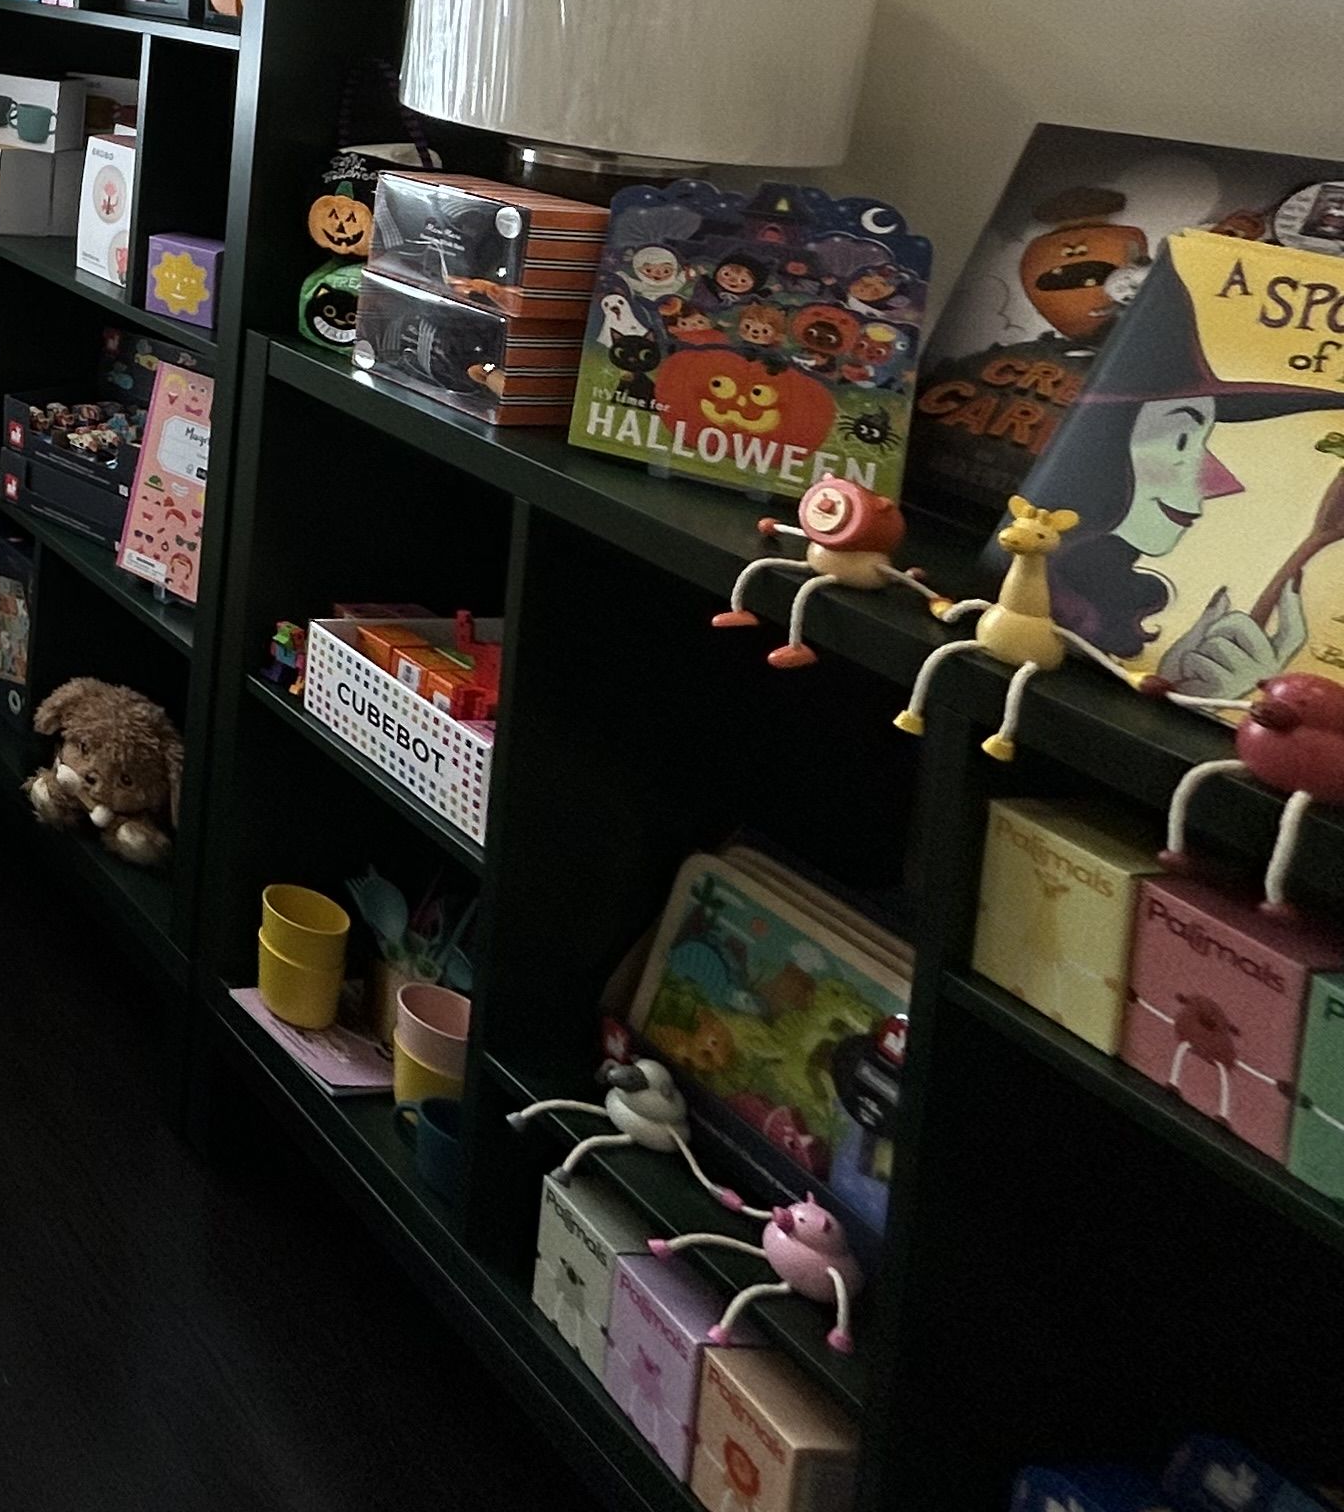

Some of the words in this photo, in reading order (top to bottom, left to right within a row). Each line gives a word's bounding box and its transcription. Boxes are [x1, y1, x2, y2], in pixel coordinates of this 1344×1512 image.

[1215, 258, 1253, 298] A
[1288, 340, 1344, 373] of
[584, 399, 880, 492] HALLOWEEN
[336, 681, 445, 775] CUBEBOT
